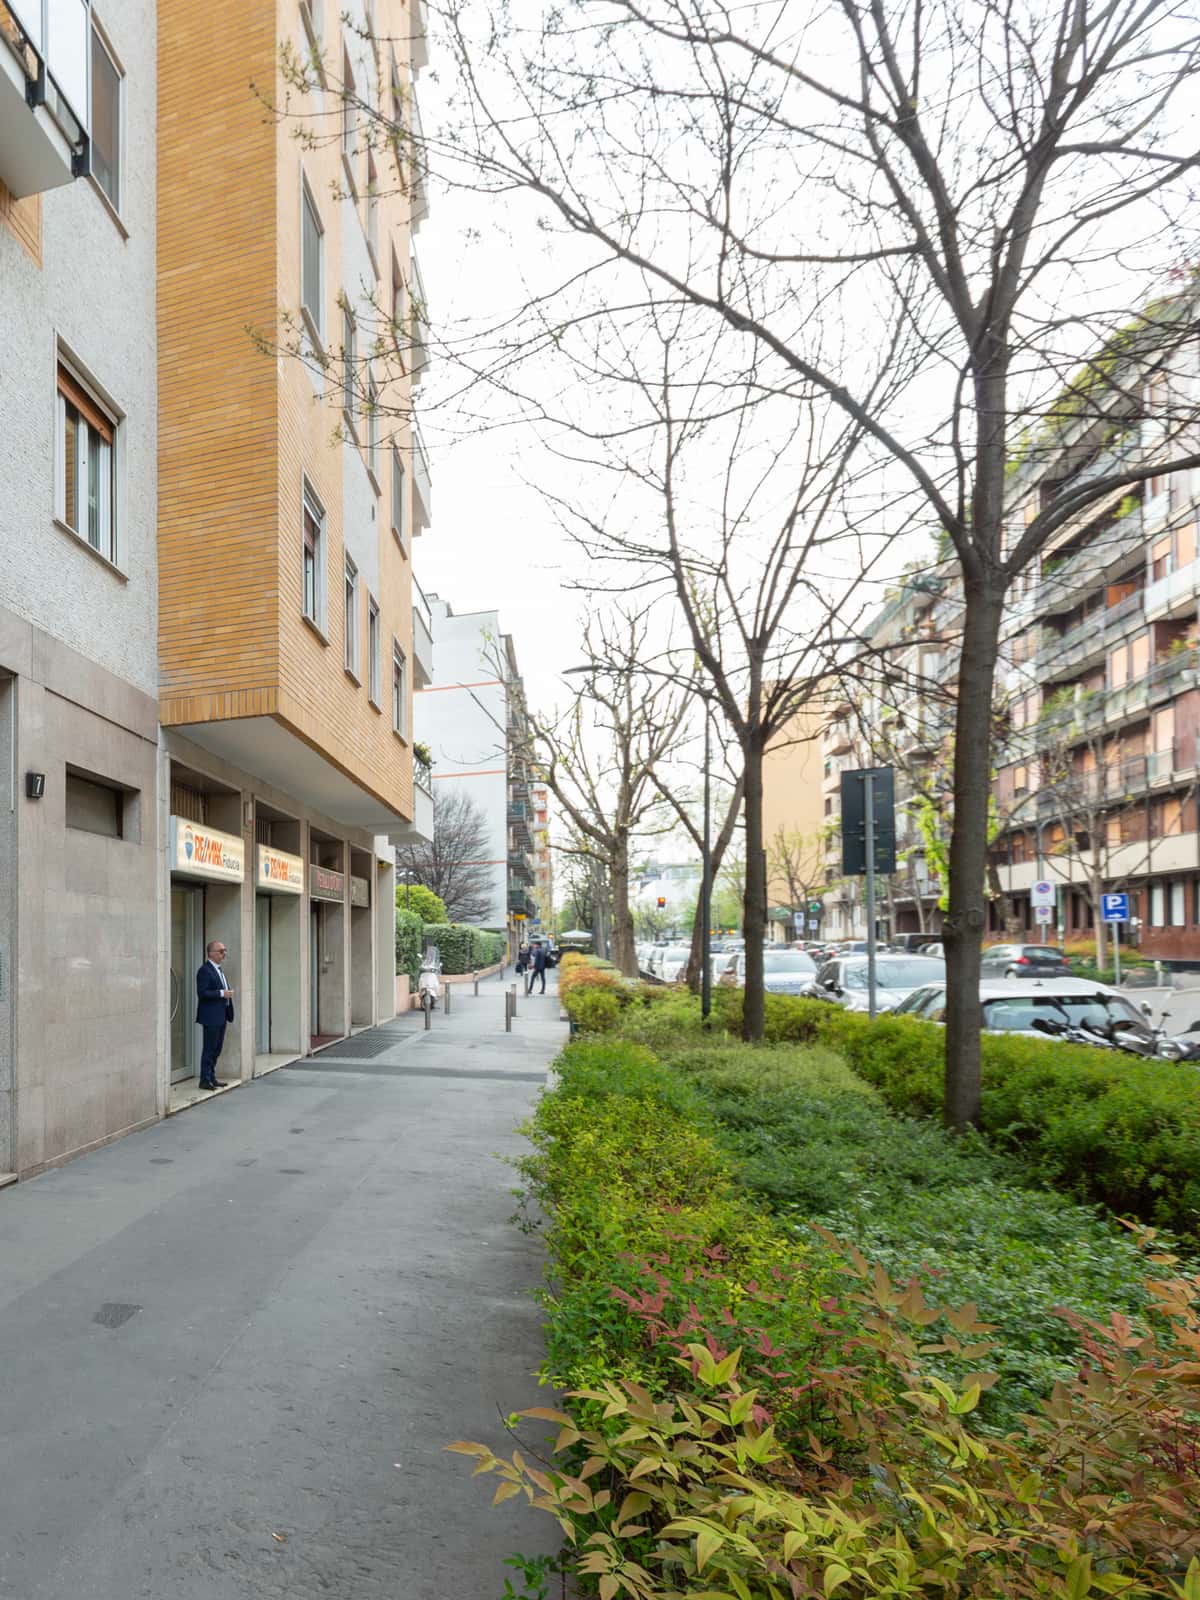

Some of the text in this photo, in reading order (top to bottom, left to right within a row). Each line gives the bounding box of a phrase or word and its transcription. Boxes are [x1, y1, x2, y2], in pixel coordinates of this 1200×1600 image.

[36, 776, 42, 794] 7
[194, 835, 223, 866] RE/MAX
[1106, 895, 1123, 910] P
